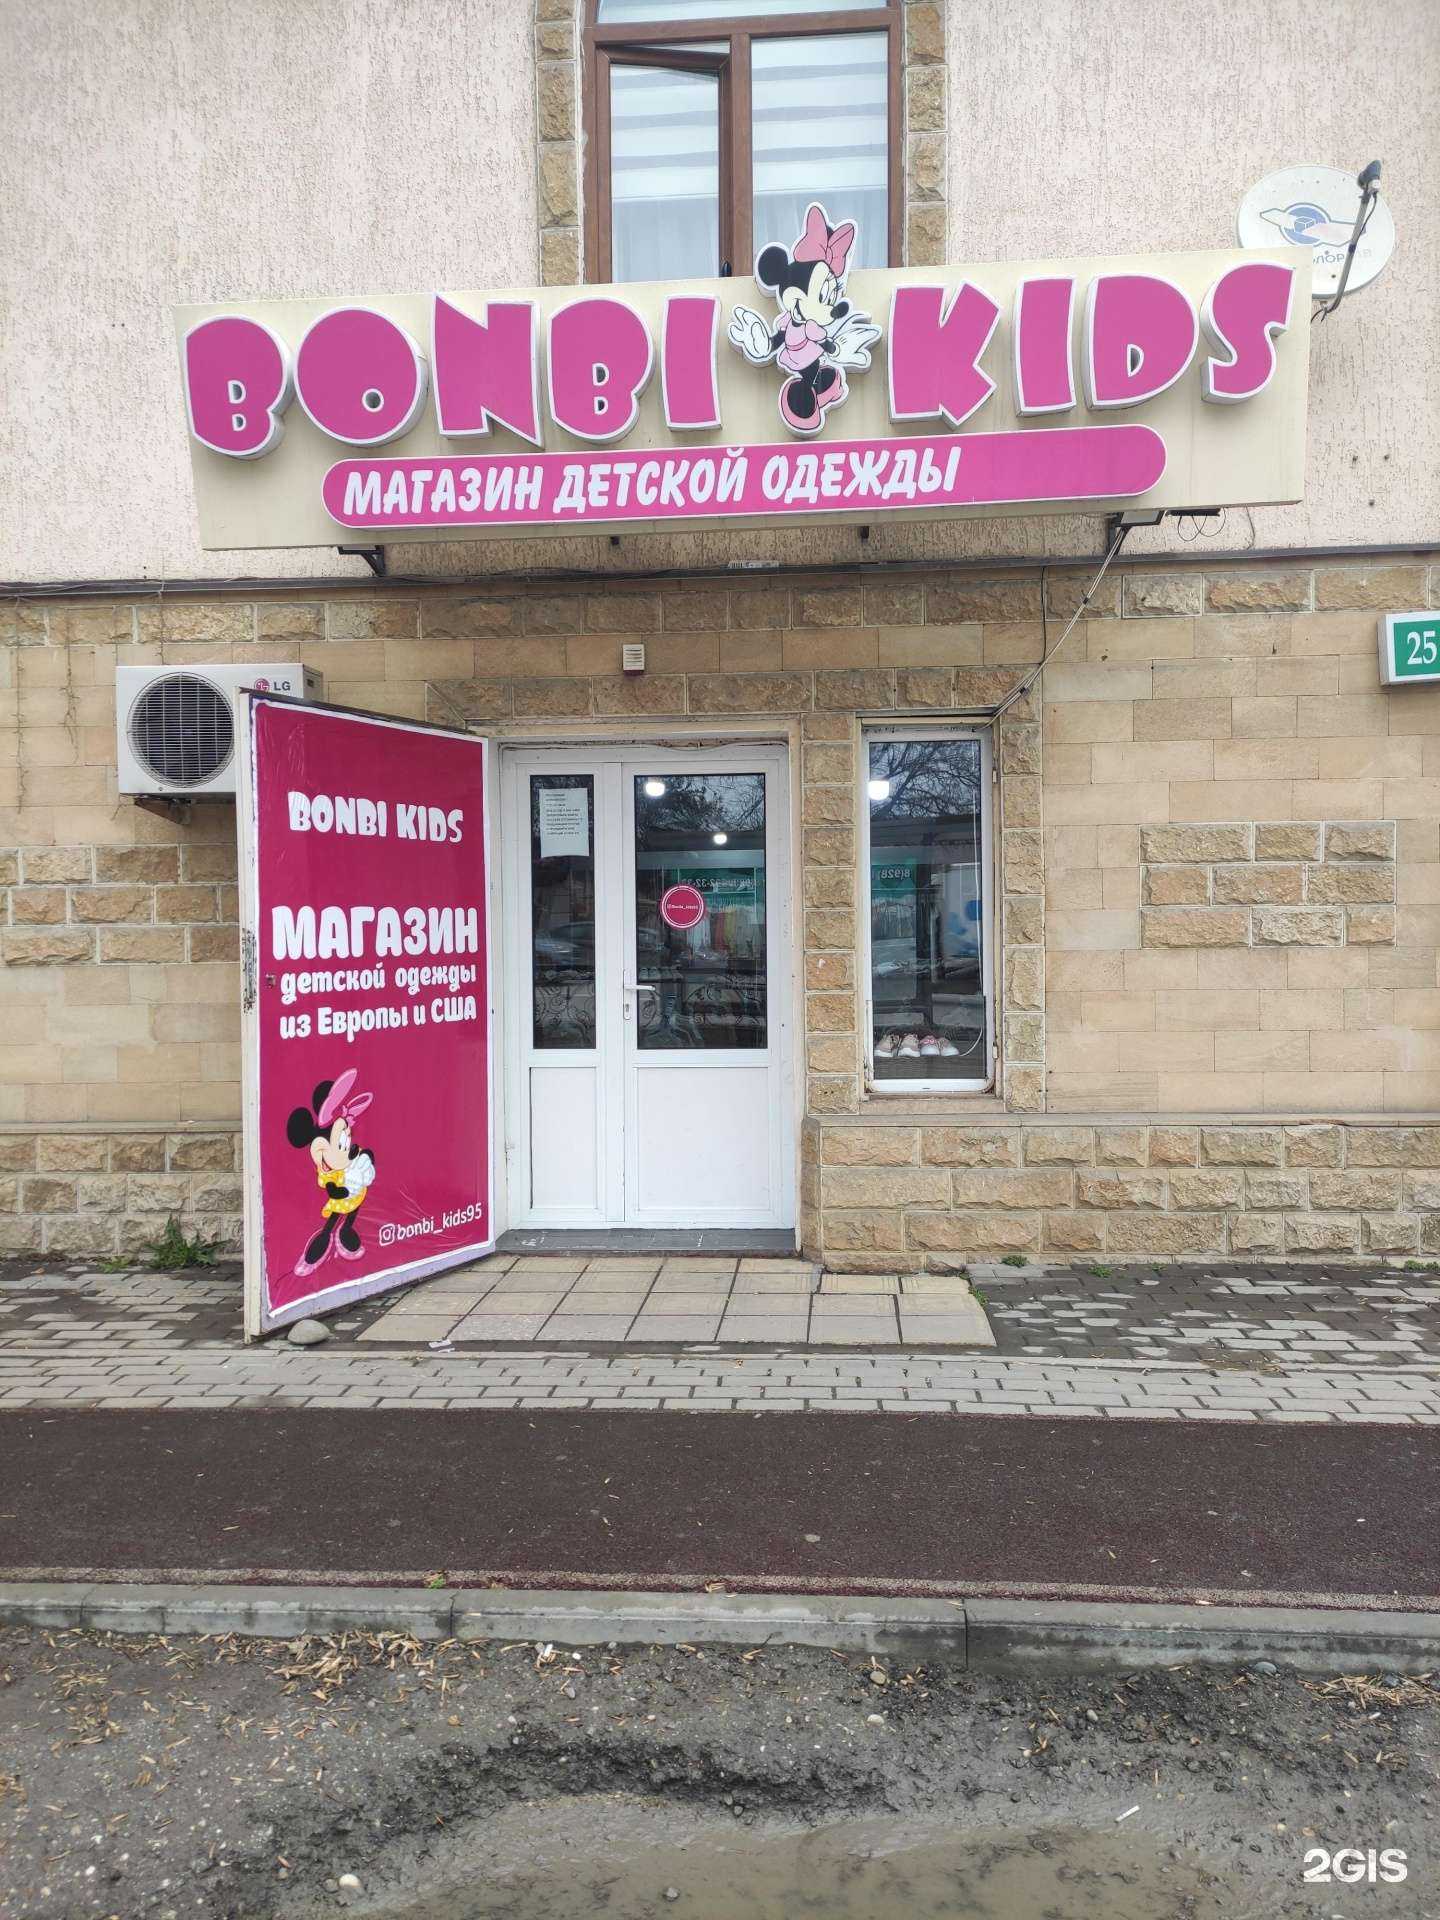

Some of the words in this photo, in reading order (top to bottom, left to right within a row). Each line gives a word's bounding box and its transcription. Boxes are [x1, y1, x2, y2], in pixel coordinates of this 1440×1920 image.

[184, 291, 722, 460] BONBI
[889, 263, 1295, 429] KIDS
[343, 466, 543, 516] МАГАЗИН
[553, 447, 747, 514] ДЕТСКОЙ
[761, 446, 962, 504] ОДЕЖДЫ
[1407, 631, 1438, 665] 25
[273, 681, 291, 691] LG
[287, 791, 387, 838] BONBI
[396, 803, 464, 843] KIDS
[271, 905, 478, 960] МАГАЗИН
[280, 962, 386, 1005] детской
[395, 964, 476, 996] одежды
[280, 1012, 311, 1039] из
[317, 1006, 408, 1042] Европы
[414, 1005, 426, 1025] и
[431, 996, 477, 1023] США
[397, 1203, 482, 1240] bonbi_kids95
